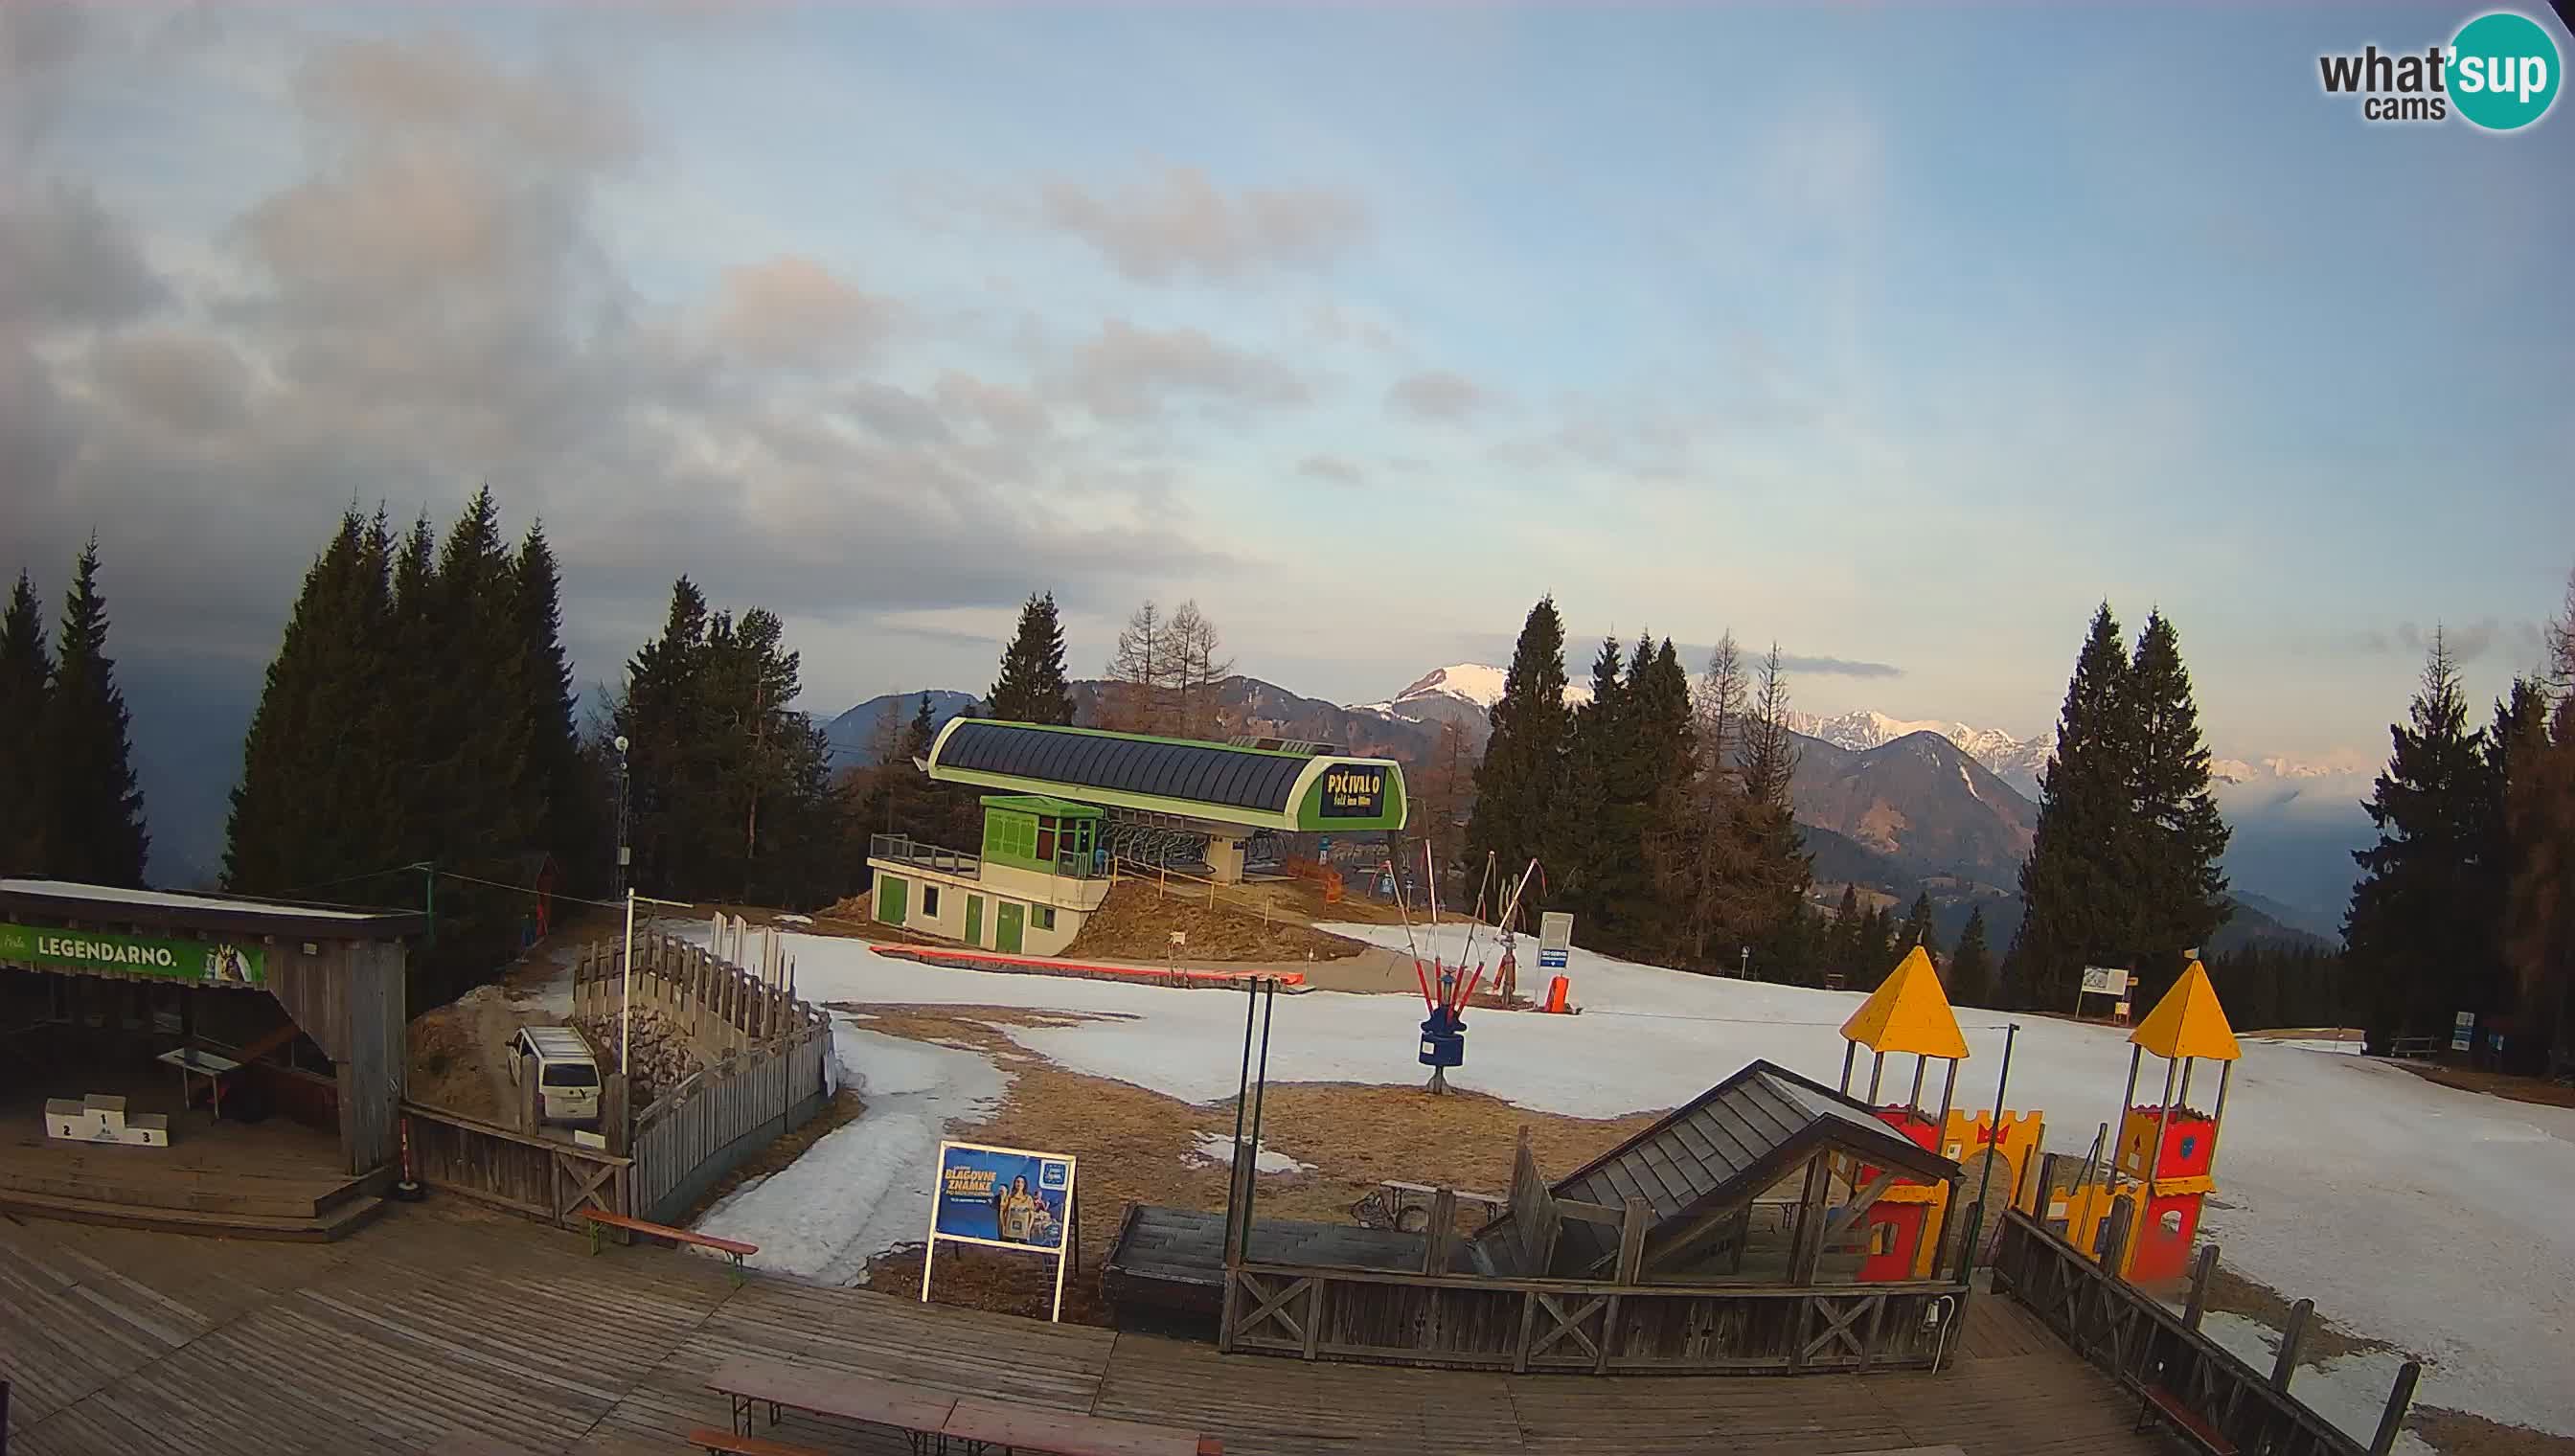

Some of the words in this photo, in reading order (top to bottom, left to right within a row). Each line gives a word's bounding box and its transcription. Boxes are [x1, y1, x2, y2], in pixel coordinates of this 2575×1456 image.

[37, 935, 177, 967] LEGENDARNO.
[101, 1113, 107, 1125] 1
[63, 1125, 72, 1136] 2
[142, 1131, 151, 1143] 3
[945, 1169, 997, 1182] BLAGOVNE
[947, 1180, 992, 1192] ZNAMKE
